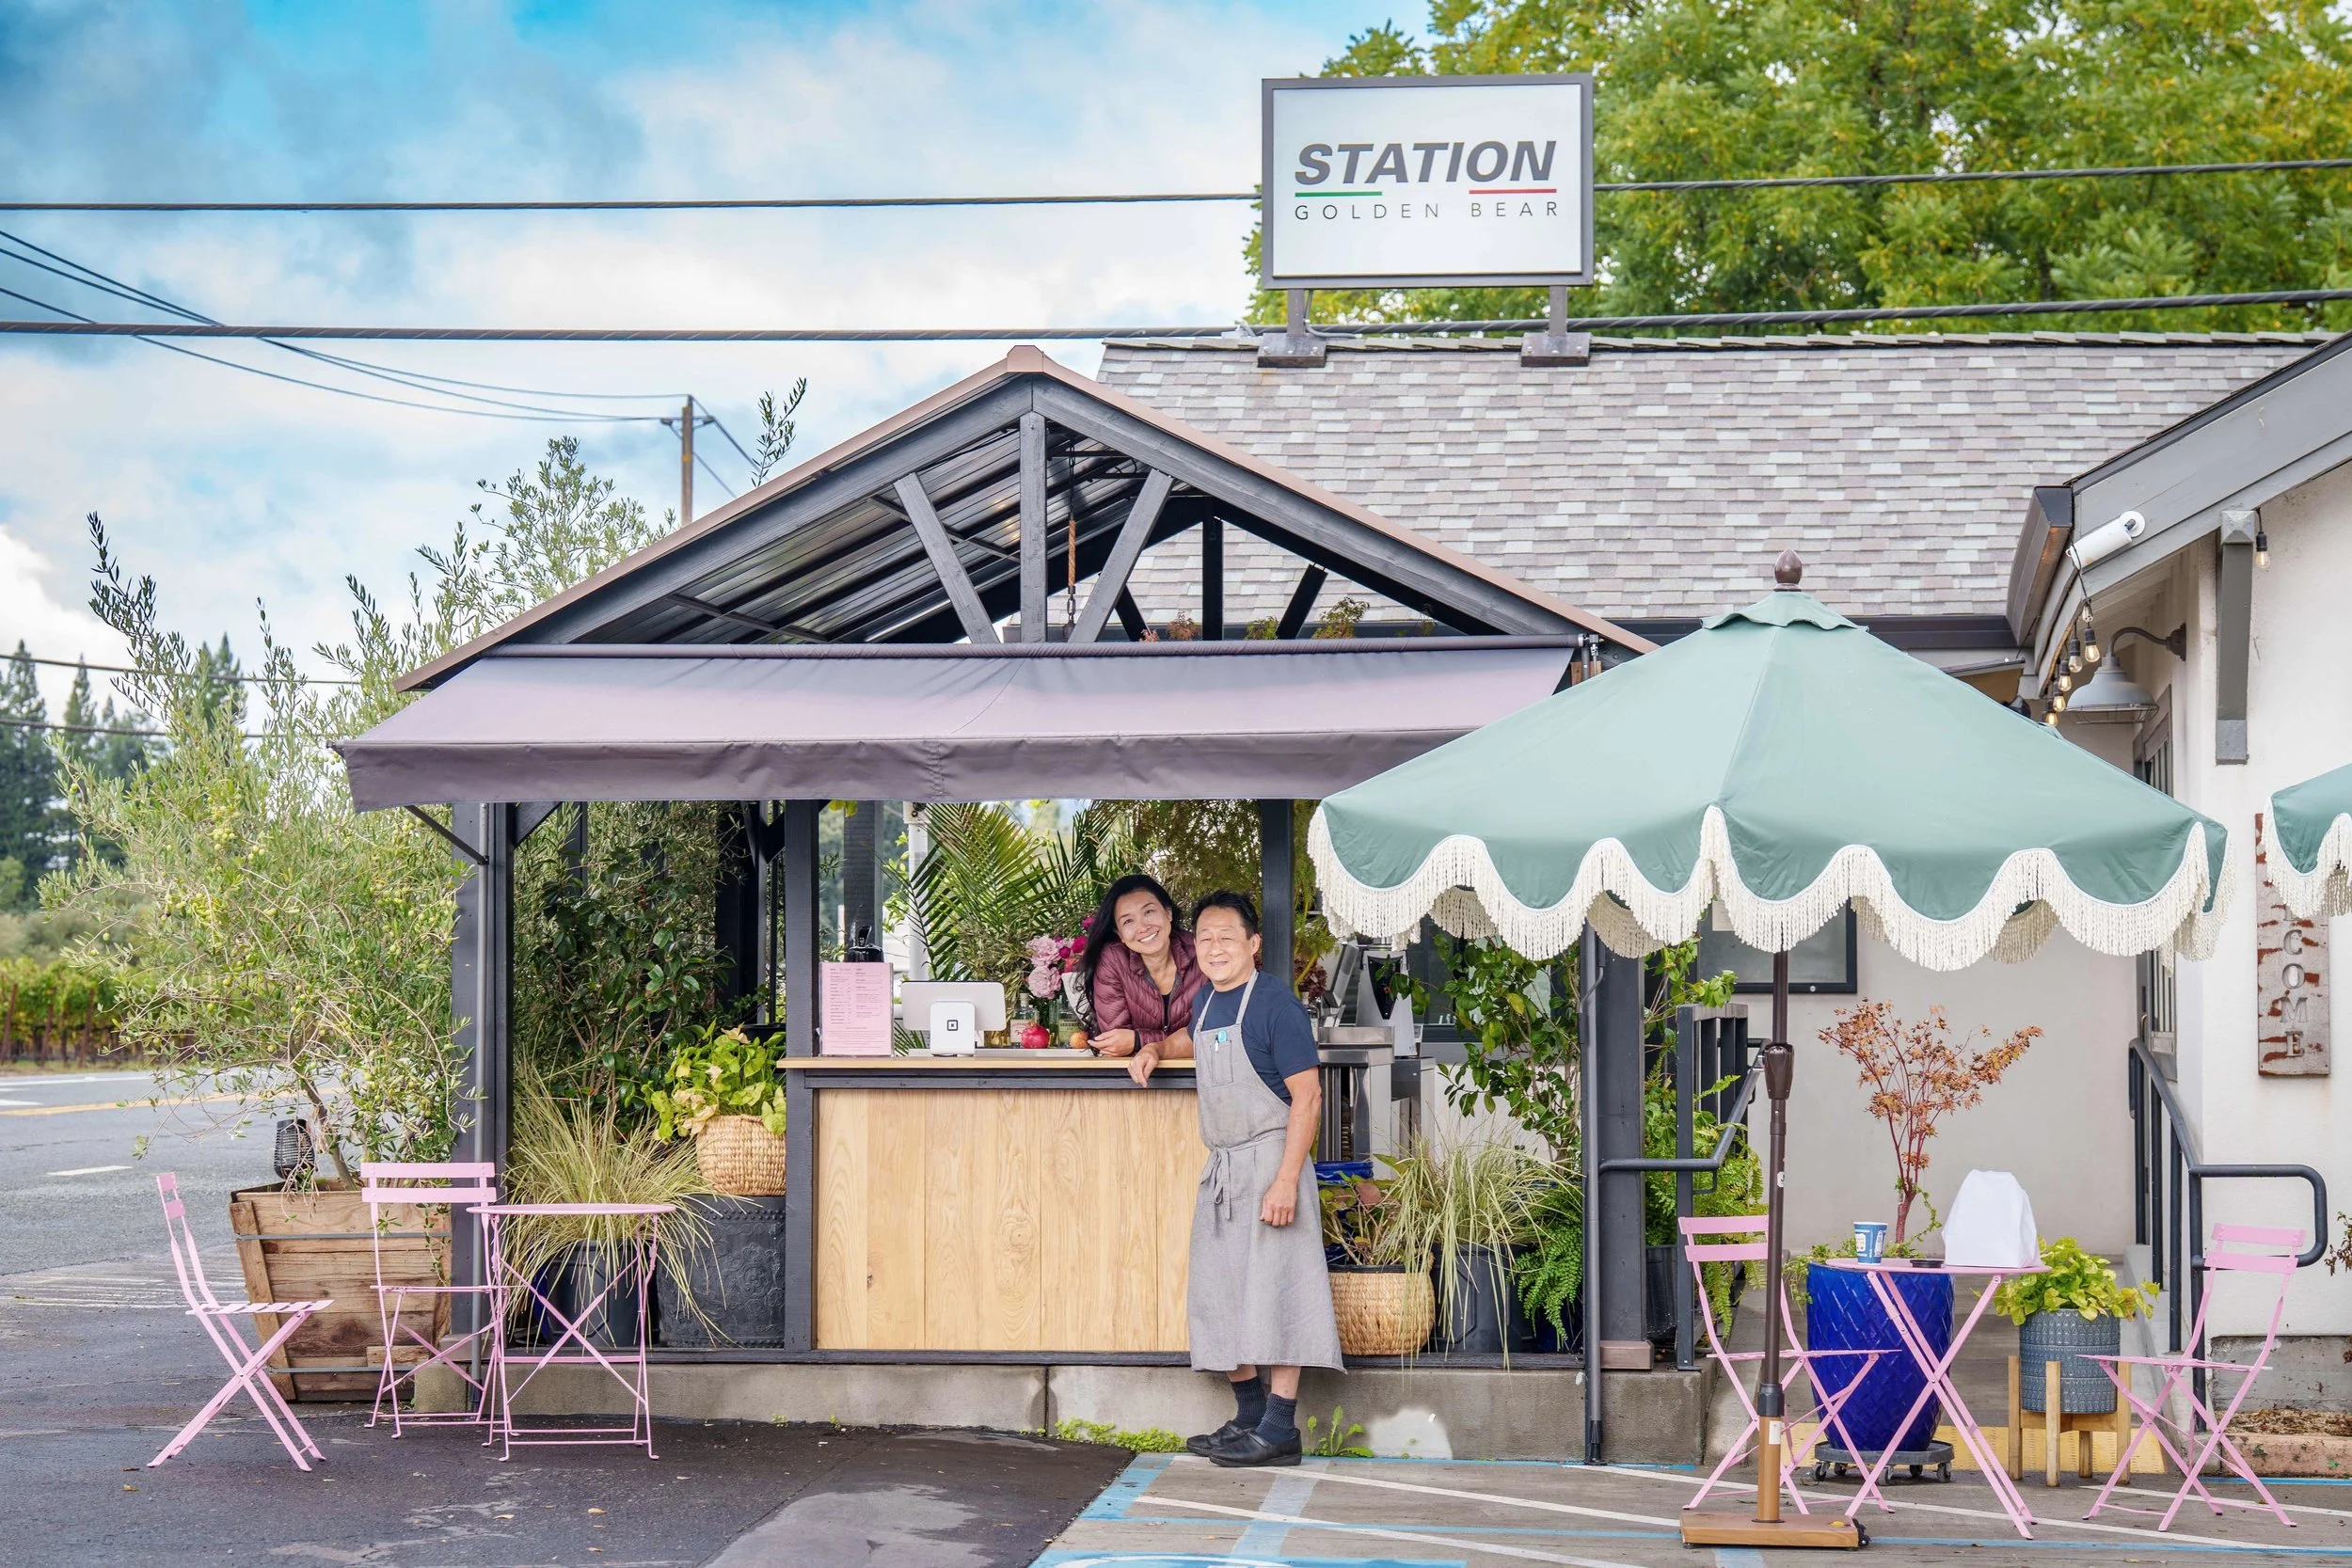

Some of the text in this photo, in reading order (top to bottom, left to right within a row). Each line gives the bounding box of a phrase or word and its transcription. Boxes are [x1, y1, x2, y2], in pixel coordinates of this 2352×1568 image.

[1295, 140, 1556, 185] STATION
[1295, 201, 1557, 220] GOLDEN BEAR
